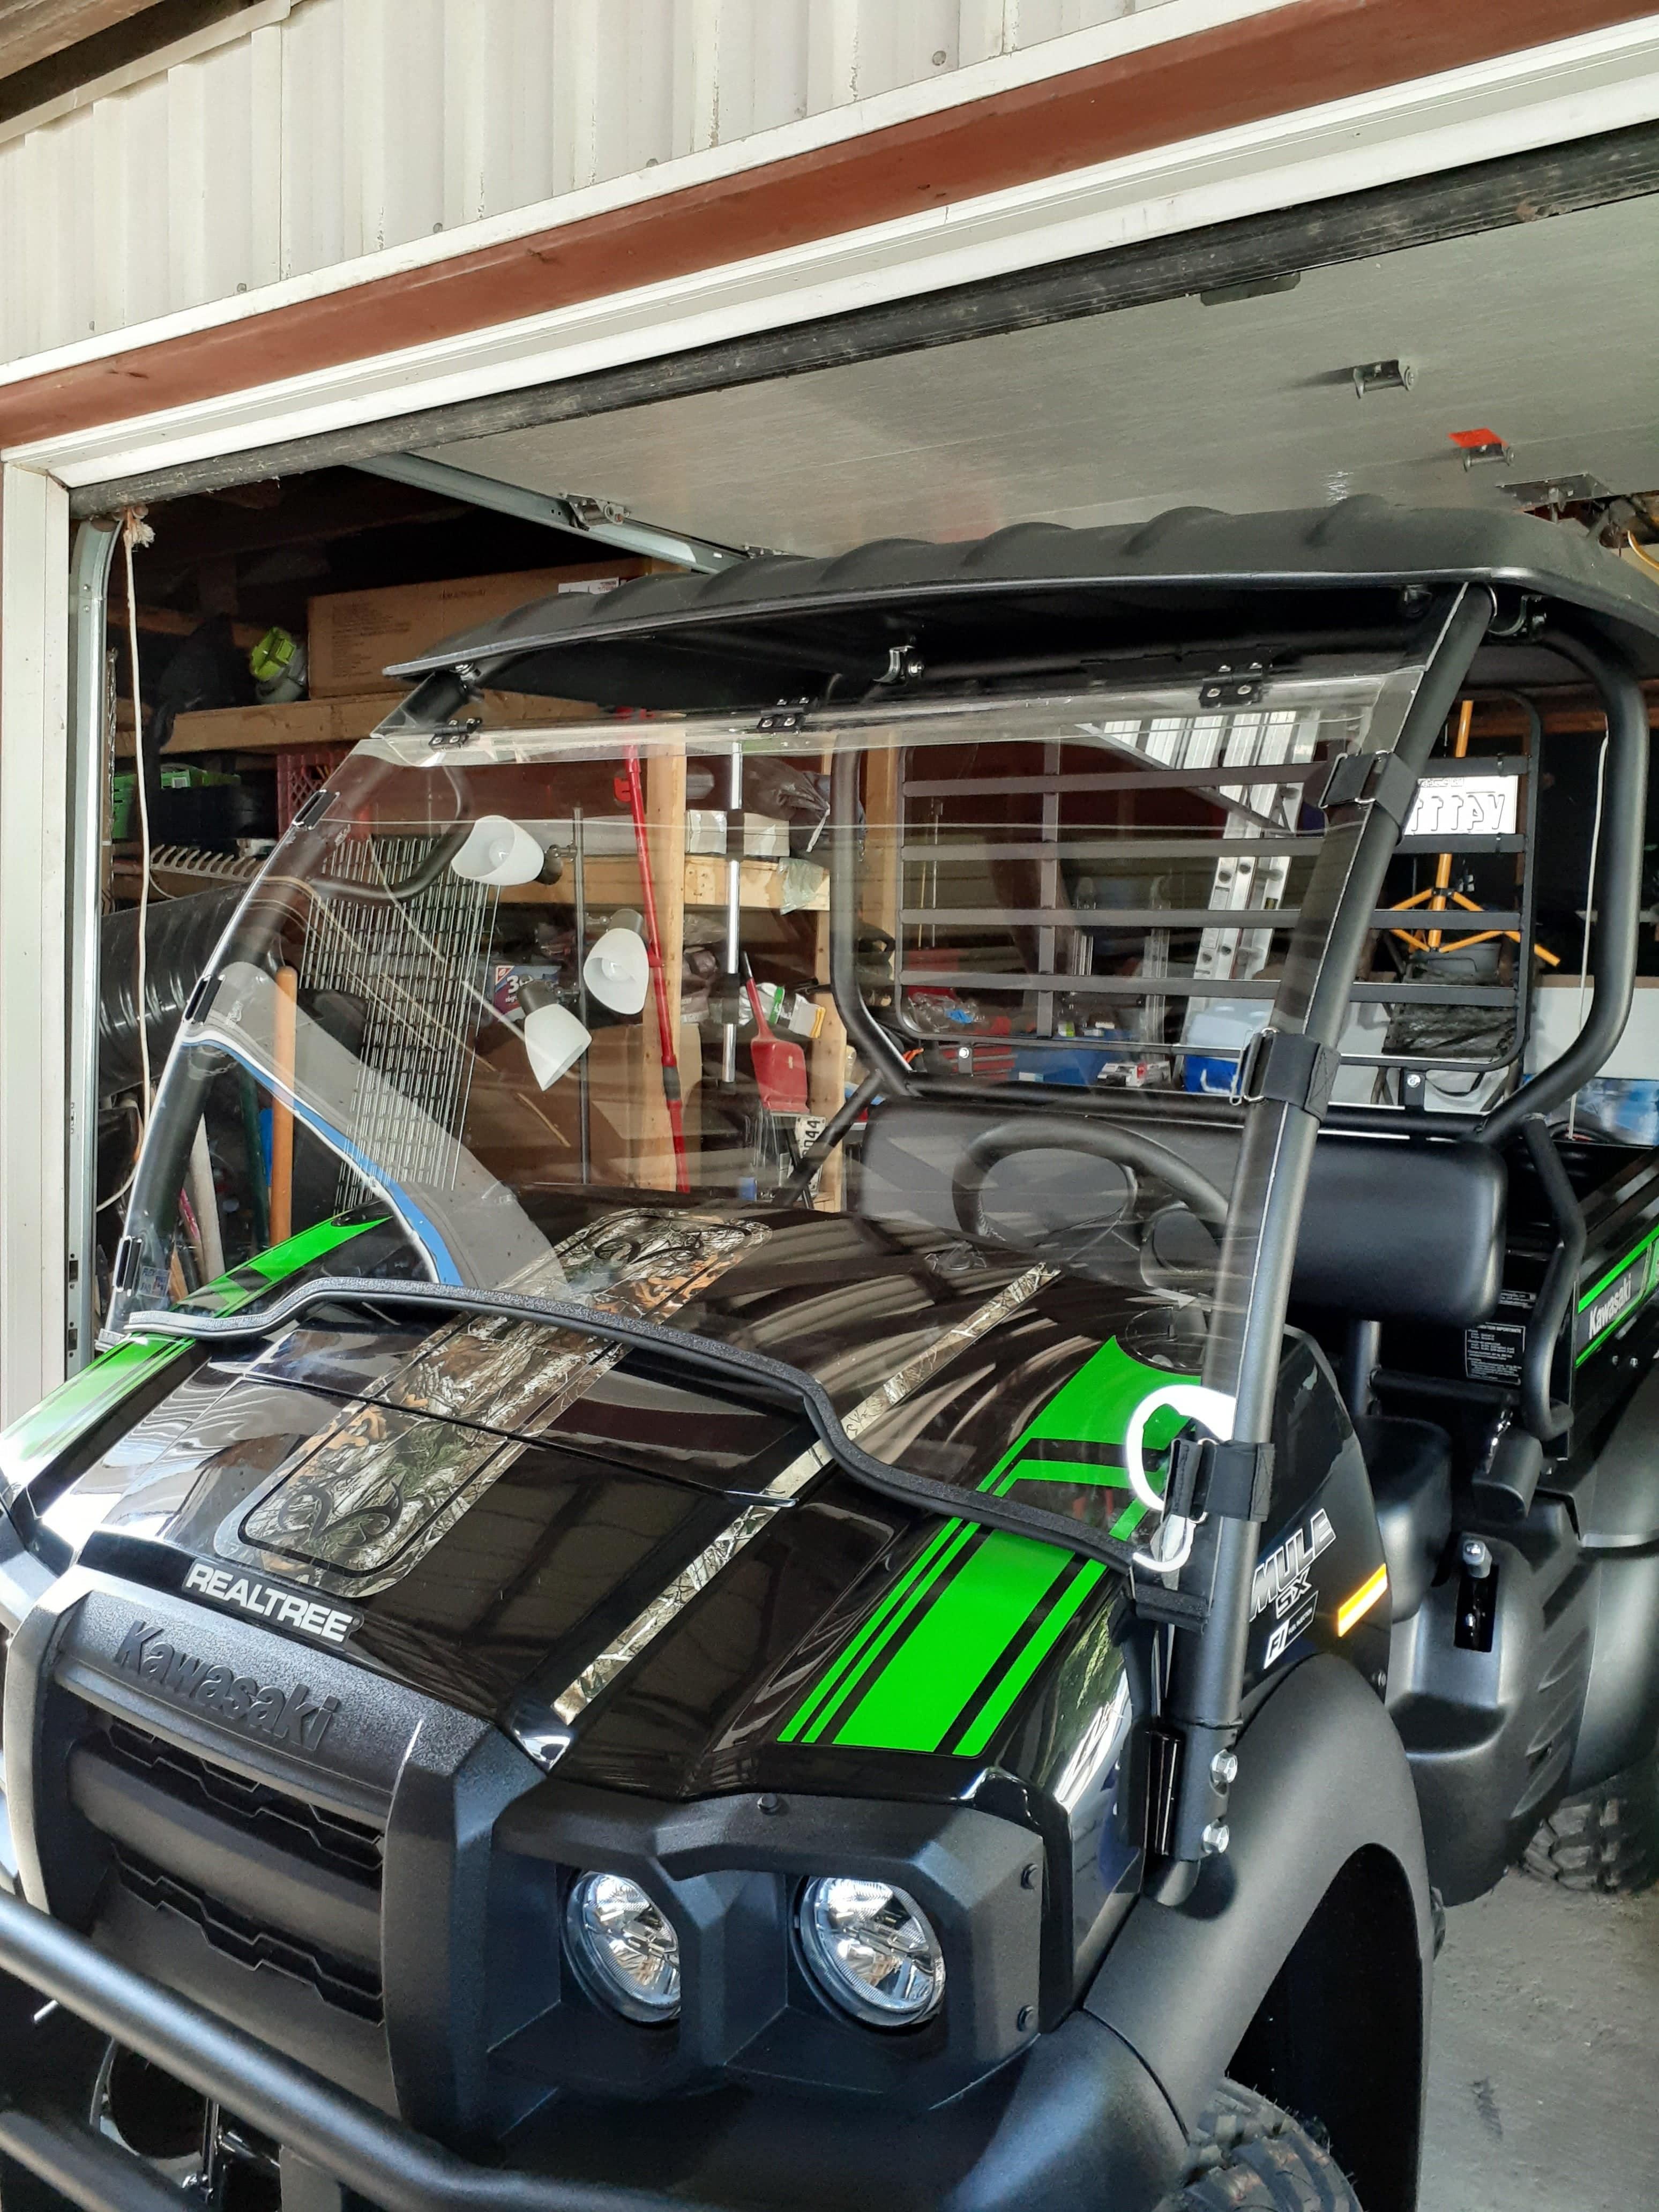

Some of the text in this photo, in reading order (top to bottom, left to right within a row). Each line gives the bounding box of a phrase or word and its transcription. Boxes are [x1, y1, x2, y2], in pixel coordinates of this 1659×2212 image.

[1589, 1273, 1632, 1339] Kawasaki
[185, 1563, 354, 1643] REALTREE
[1249, 1508, 1336, 1623] MULE
[114, 1619, 340, 1751] Kawasaki
